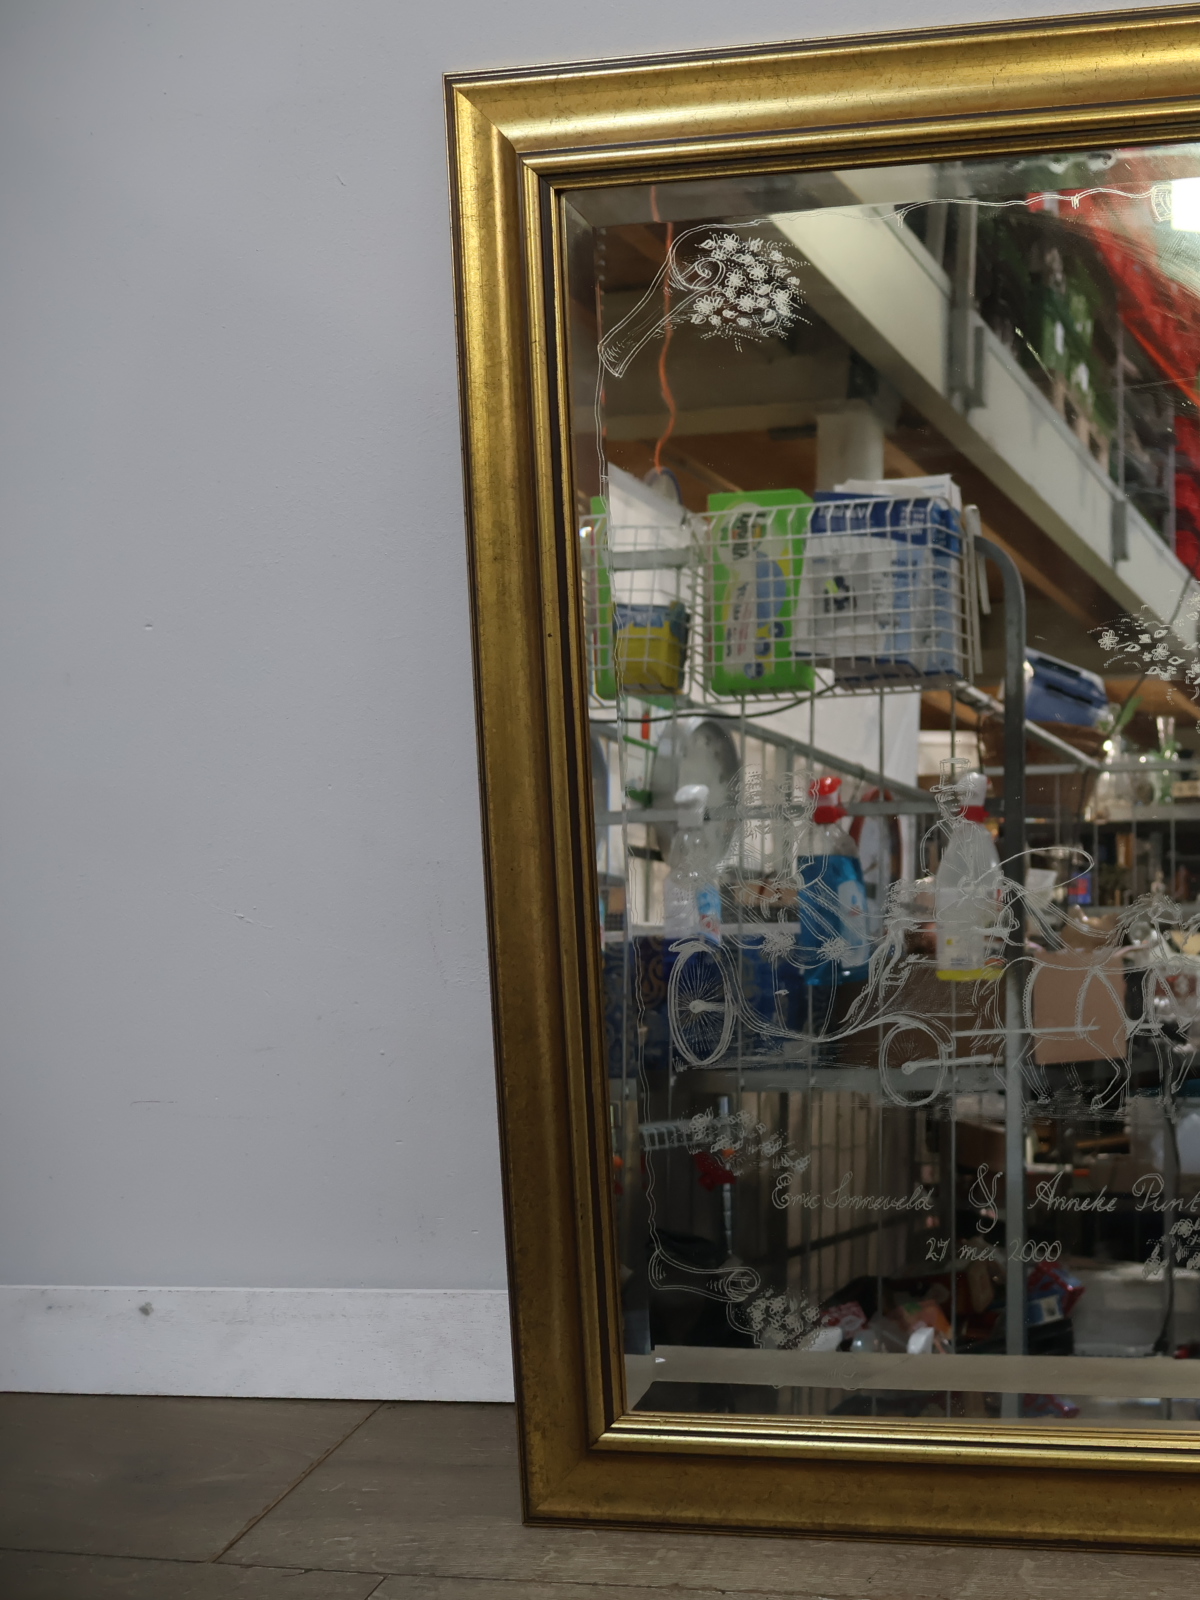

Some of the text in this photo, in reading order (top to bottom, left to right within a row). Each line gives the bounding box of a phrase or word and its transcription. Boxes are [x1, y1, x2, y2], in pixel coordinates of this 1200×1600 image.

[968, 1162, 1004, 1234] &
[1026, 1170, 1118, 1212] Anneke
[924, 1236, 1063, 1263] 27 mei 2000
